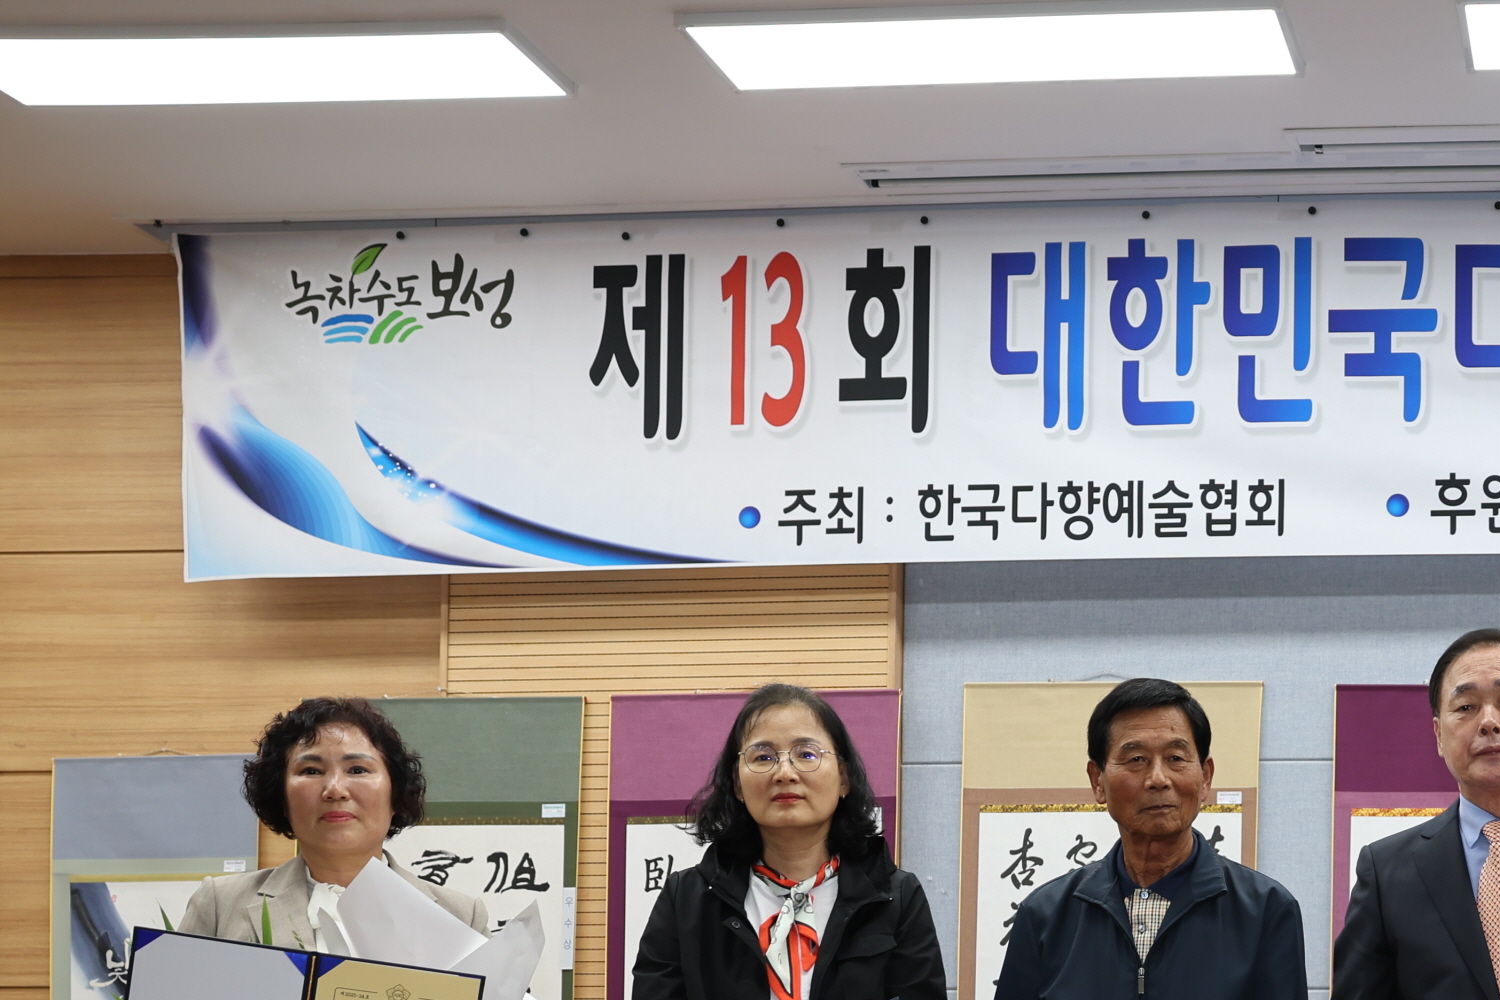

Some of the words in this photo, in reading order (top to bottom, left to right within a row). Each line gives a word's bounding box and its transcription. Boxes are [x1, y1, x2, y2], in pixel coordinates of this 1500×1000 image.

[285, 267, 423, 325] 녹차수도
[426, 252, 515, 329] 보성
[777, 486, 864, 546] 주최
[917, 477, 1287, 542] 한국다향예술협회
